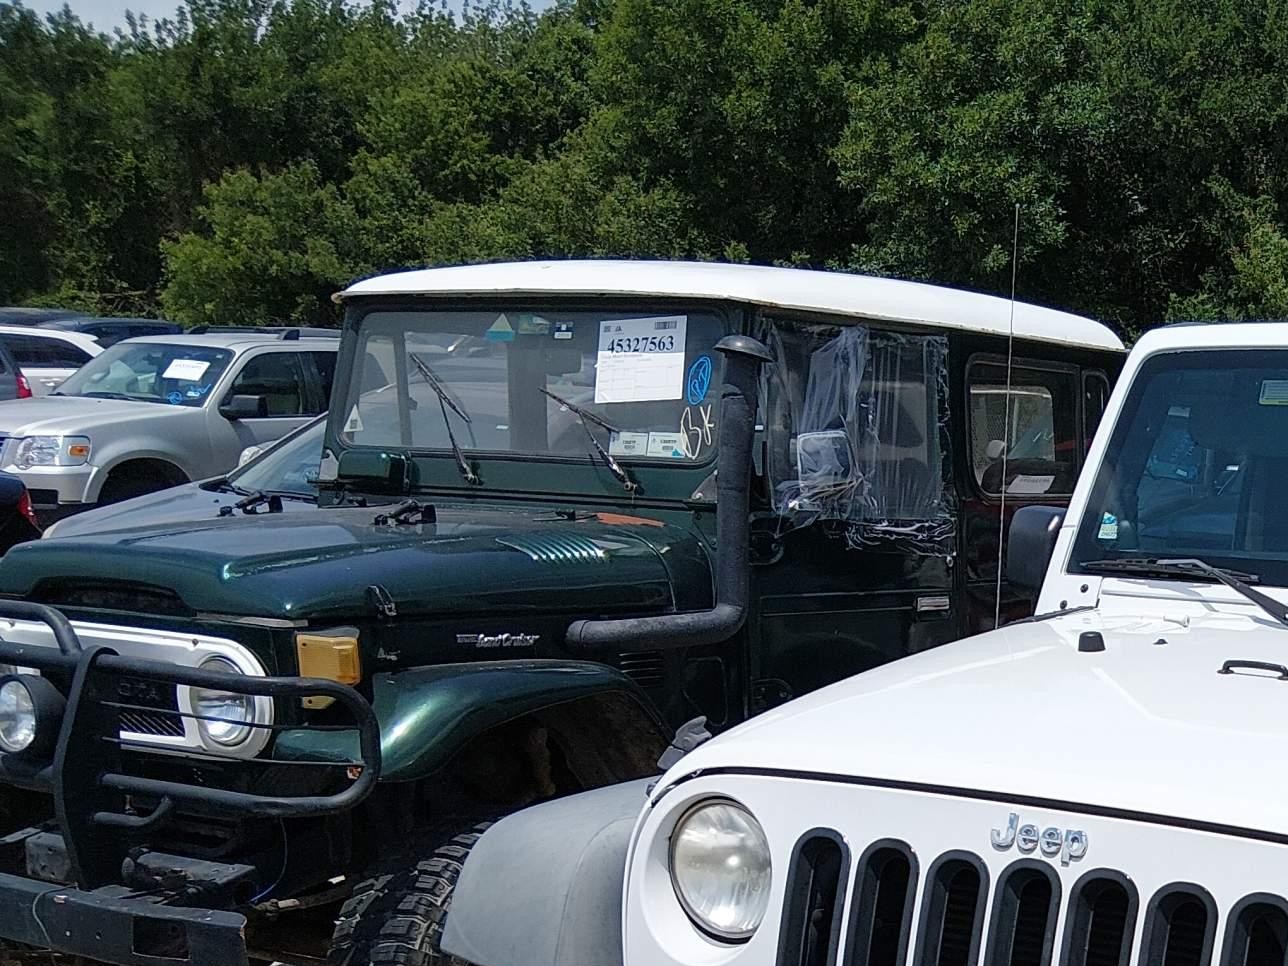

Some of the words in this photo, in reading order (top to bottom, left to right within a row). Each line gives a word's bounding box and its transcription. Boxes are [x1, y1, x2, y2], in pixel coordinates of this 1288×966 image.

[607, 335, 674, 354] 45327563
[475, 633, 502, 648] Land
[501, 632, 540, 647] Cruiser
[990, 812, 1089, 868] Jeep
